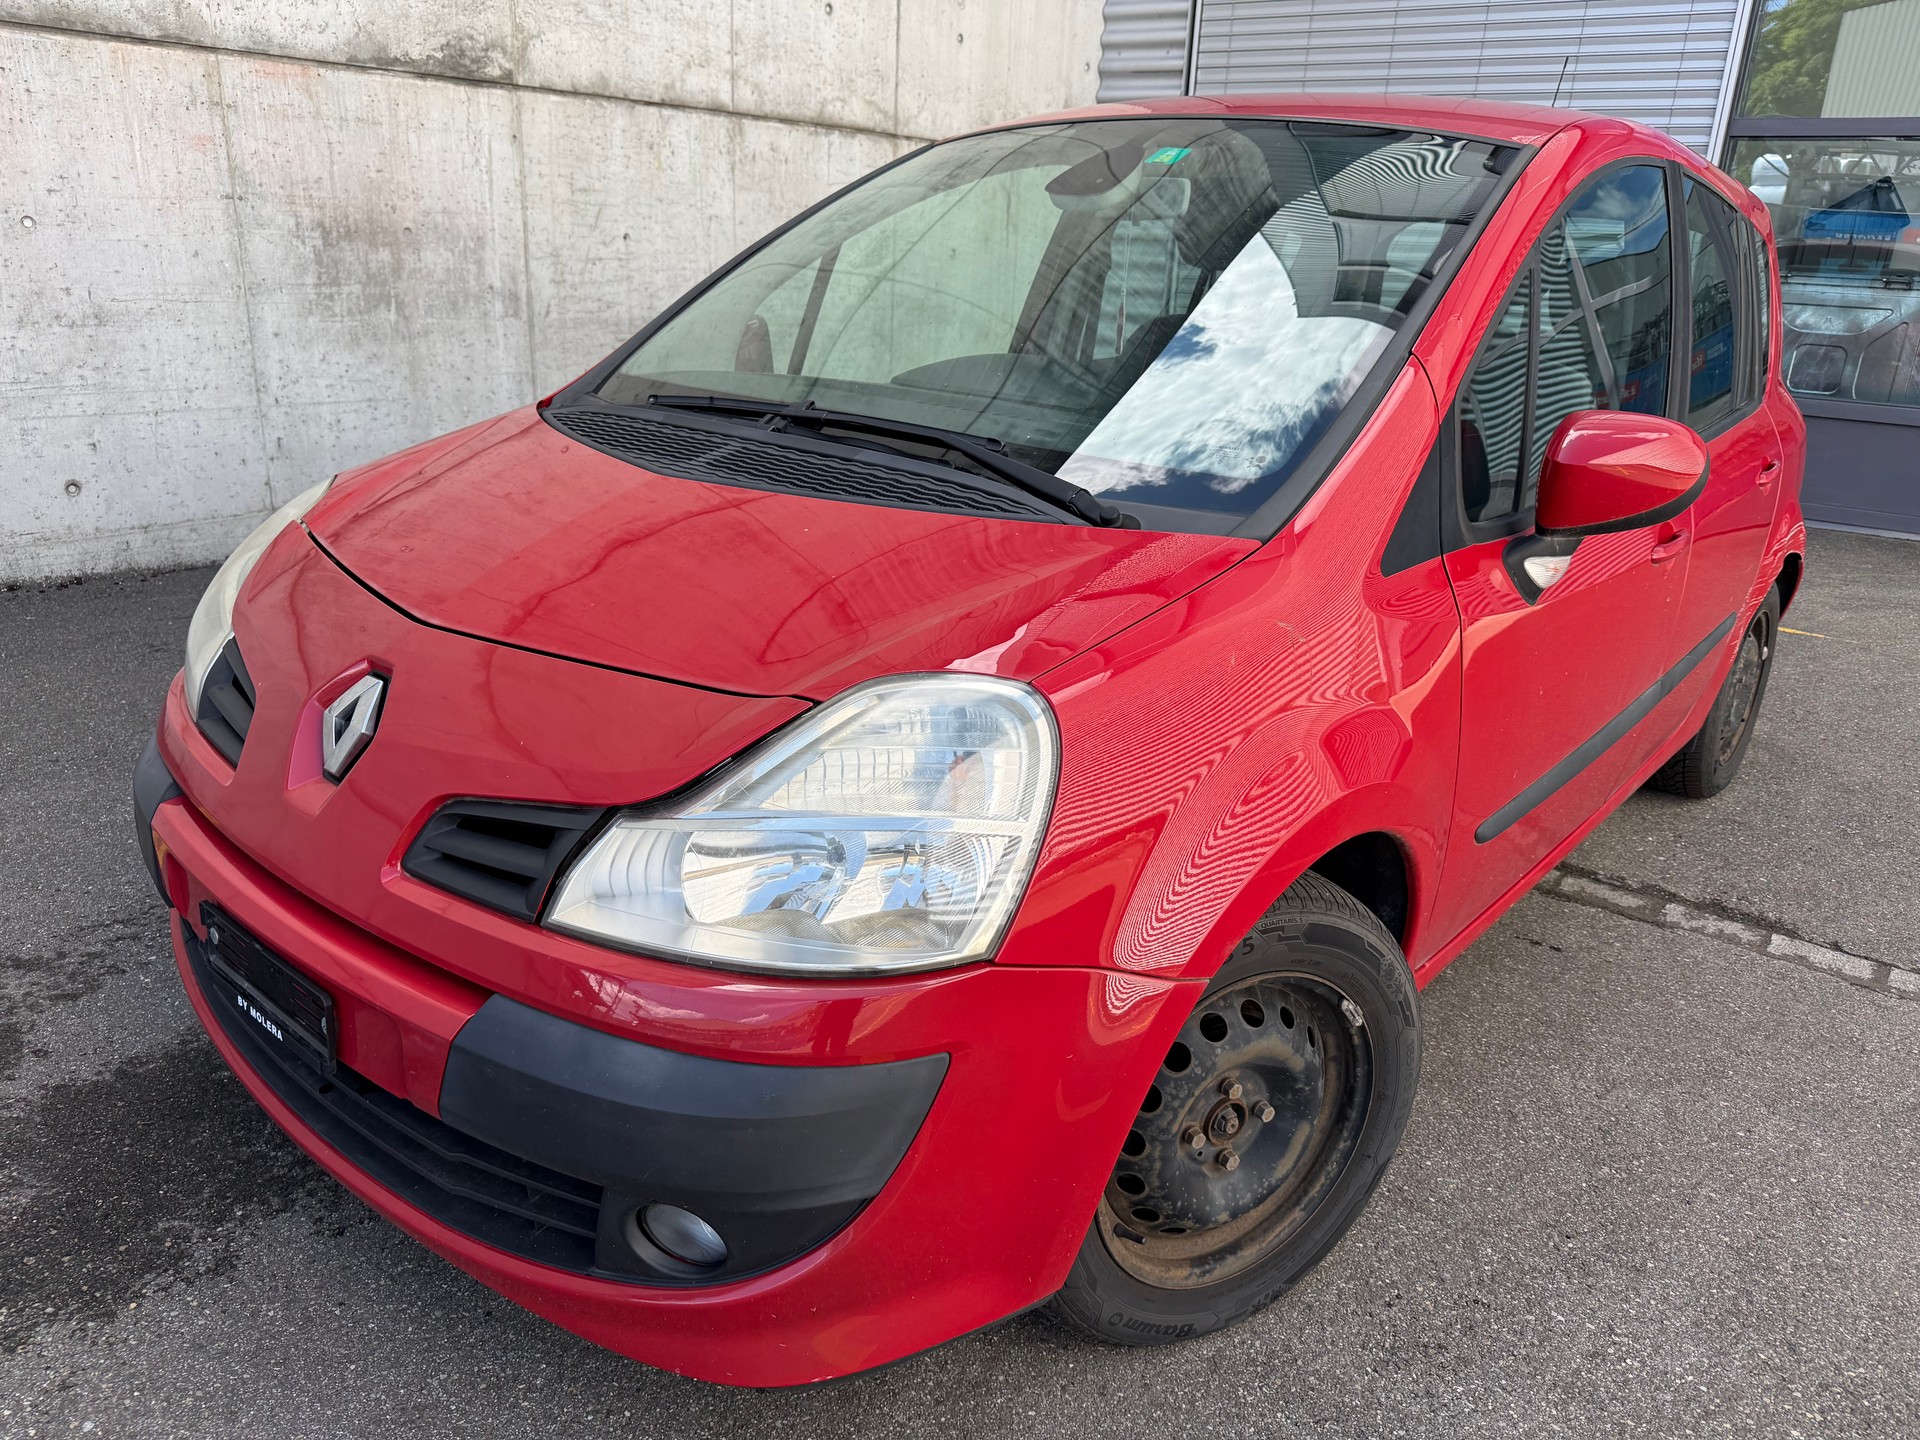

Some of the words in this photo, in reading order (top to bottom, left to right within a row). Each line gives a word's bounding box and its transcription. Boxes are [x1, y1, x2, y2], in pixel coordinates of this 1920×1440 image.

[1261, 917, 1298, 928] QUARTARIS
[1242, 936, 1255, 955] 5
[237, 995, 247, 1010] BY
[250, 1006, 283, 1041] MOLERA
[1122, 1317, 1197, 1338] Barum
